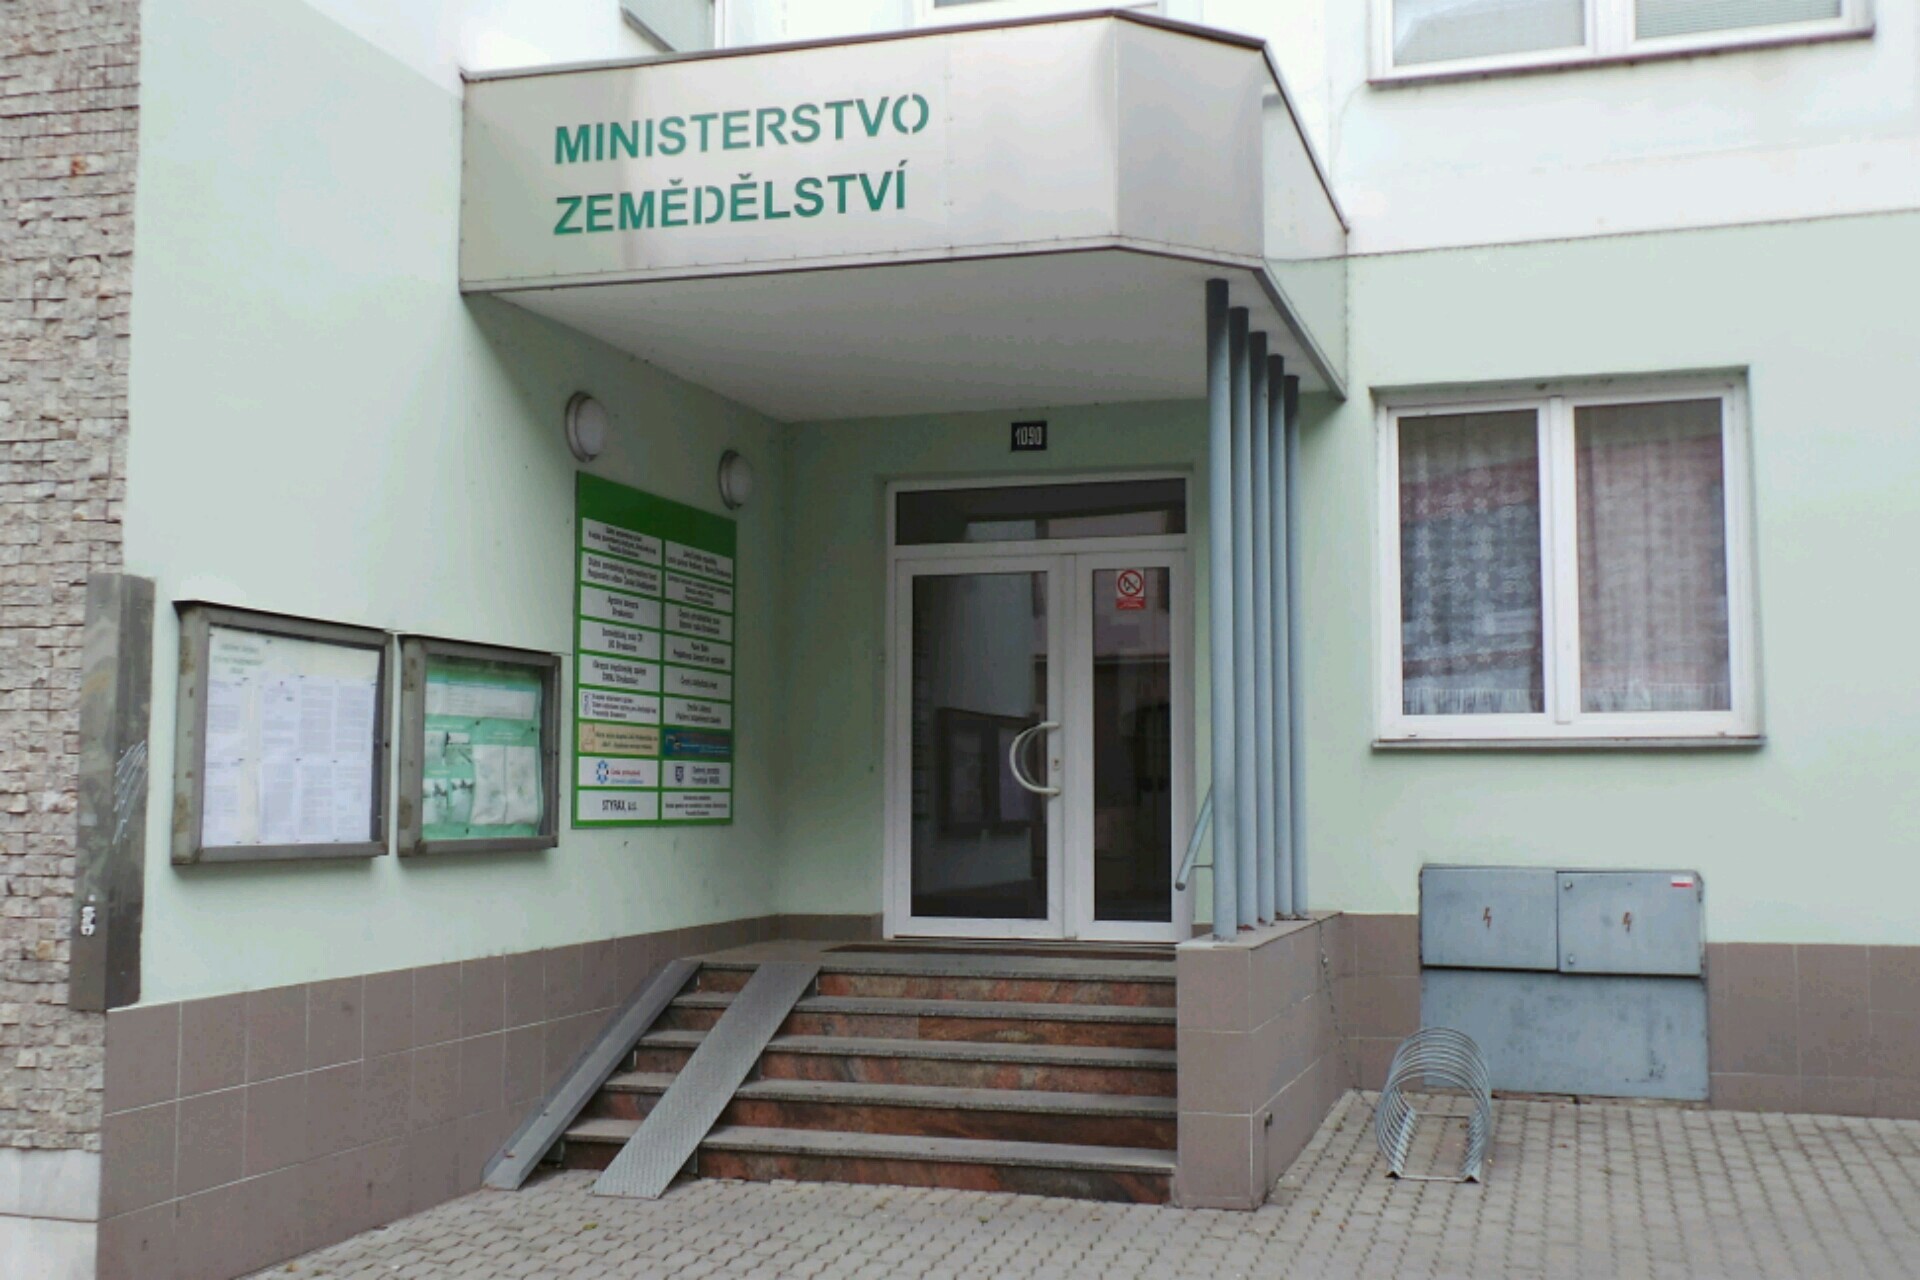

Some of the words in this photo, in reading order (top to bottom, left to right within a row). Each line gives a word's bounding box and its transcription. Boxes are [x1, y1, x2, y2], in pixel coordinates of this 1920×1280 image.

[554, 93, 930, 164] MINISTERSTVO
[553, 159, 909, 235] ZEMĚDĚLSTVÍ
[1015, 426, 1042, 445] 1090
